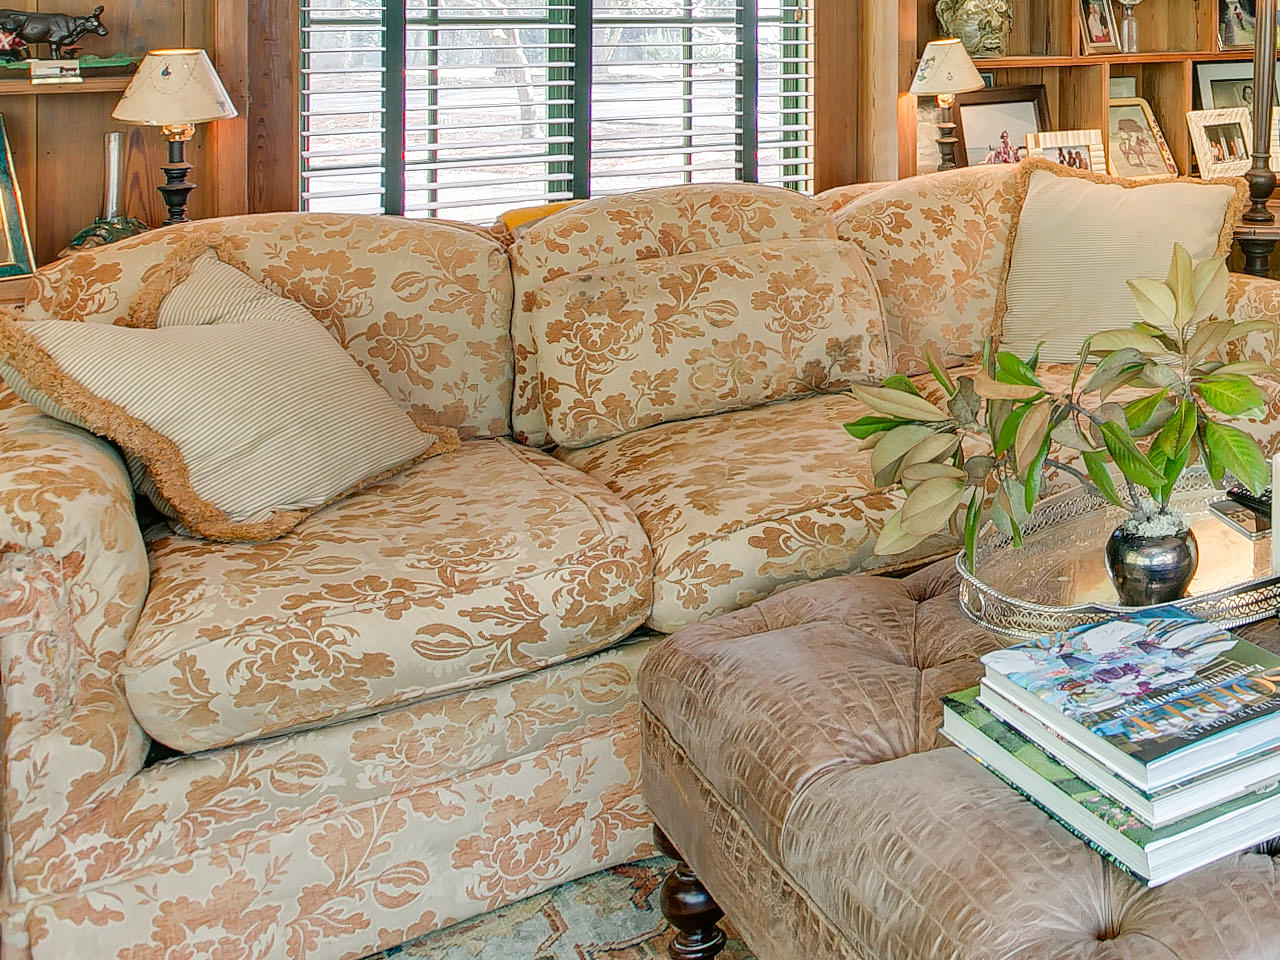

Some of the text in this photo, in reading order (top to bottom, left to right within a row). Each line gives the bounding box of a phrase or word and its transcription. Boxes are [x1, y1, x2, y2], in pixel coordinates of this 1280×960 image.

[1112, 663, 1265, 717] Entertaining with Style
[1181, 712, 1236, 740] ROLLINS
